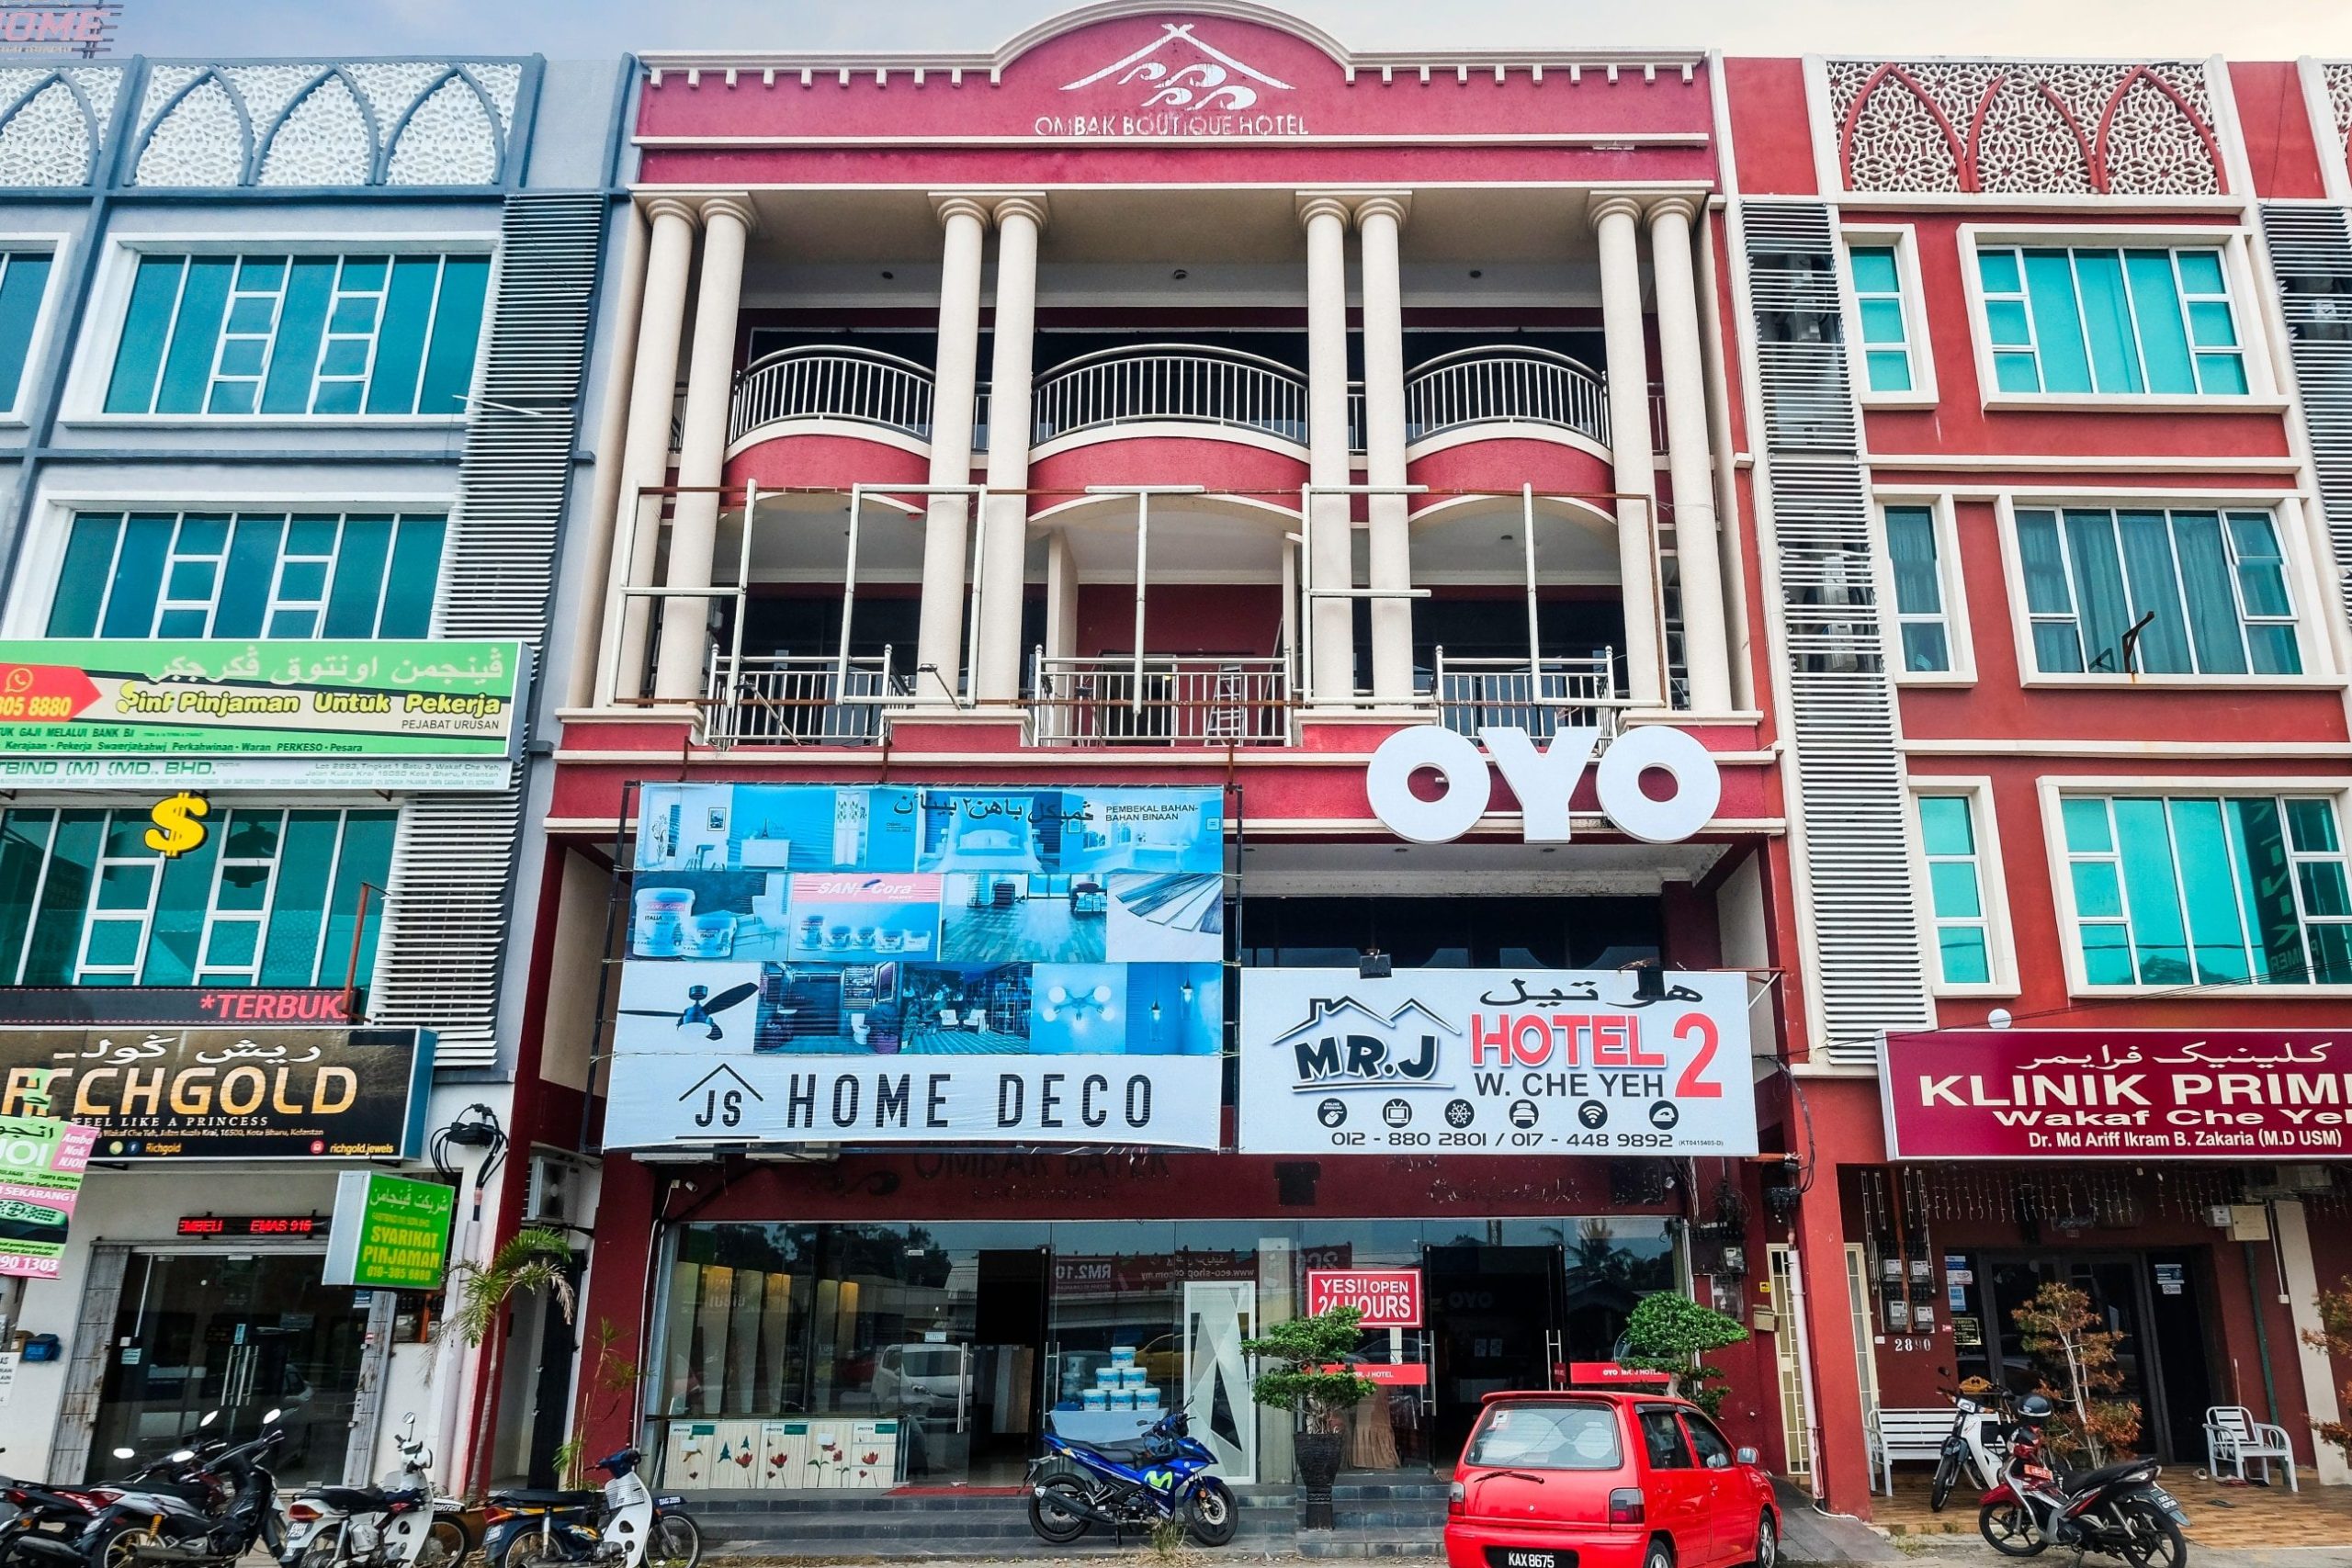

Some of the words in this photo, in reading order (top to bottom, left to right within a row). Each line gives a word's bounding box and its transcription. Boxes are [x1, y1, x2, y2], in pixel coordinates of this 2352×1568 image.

[0, 11, 110, 41] OME
[1035, 116, 1115, 136] OMBAK
[1123, 113, 1232, 136] BOUTIQUE
[1239, 115, 1309, 135] HOTEL
[28, 696, 72, 716] 8880
[177, 690, 300, 717] Pinjaman
[313, 692, 391, 714] Untuk
[403, 692, 502, 718] Pekerja
[46, 728, 87, 737] MELALUI
[93, 728, 119, 737] BANK
[401, 720, 449, 729] PEJABAT
[454, 720, 500, 729] URUSAN
[6, 741, 47, 751] Kerajaan
[56, 741, 92, 751] Pekerja
[172, 742, 233, 751] Perkahwinan
[242, 743, 271, 751] Waran
[277, 743, 322, 752] PERKESO
[329, 743, 363, 752] Pesara
[1366, 725, 1722, 844] OYO
[1105, 814, 1140, 822] BAHAN
[1142, 813, 1179, 821] BINAAN
[1106, 805, 1159, 814] PEMBEKAL
[1161, 804, 1199, 812] BAHAN-
[1292, 1033, 1440, 1082] MR.J
[1471, 1013, 1668, 1068] HOTEL
[1673, 1012, 1724, 1099] 2
[1475, 1073, 1510, 1098] W.
[1522, 1073, 1589, 1098] CHE
[1598, 1073, 1664, 1098] YEH
[1918, 1074, 2153, 1108] KLINIK
[694, 1089, 743, 1129] JS
[787, 1073, 952, 1129] HOME
[998, 1073, 1153, 1129] DECO
[121, 1117, 160, 1127] LIKE
[167, 1117, 178, 1127] A
[187, 1117, 269, 1127] PRINCESS
[1992, 1110, 2151, 1127] Wakaf
[2165, 1110, 2266, 1126] Che
[1331, 1133, 1366, 1145] 012
[1388, 1133, 1431, 1146] 880
[1439, 1133, 1487, 1146] 2801
[1511, 1133, 1544, 1146] 017
[1566, 1134, 1610, 1146] 448
[1617, 1134, 1673, 1147] 9892
[2029, 1133, 2053, 1148] Dr.
[2057, 1133, 2082, 1148] Md
[2085, 1132, 2121, 1148] Ariff
[2124, 1132, 2169, 1148] Ikram
[2173, 1132, 2192, 1147] B.
[2195, 1131, 2256, 1147] Zakaria
[2257, 1129, 2295, 1147] (M.D
[2299, 1128, 2342, 1147] USM)
[370, 1225, 439, 1249] SYARIKAT
[22, 1257, 59, 1273] 1303
[362, 1245, 440, 1269] PINJAMAN
[1319, 1279, 1367, 1294] YES!!
[1369, 1280, 1408, 1293] OPEN
[1508, 1552, 1528, 1567] KAX
[1528, 1554, 1555, 1568] 8675
